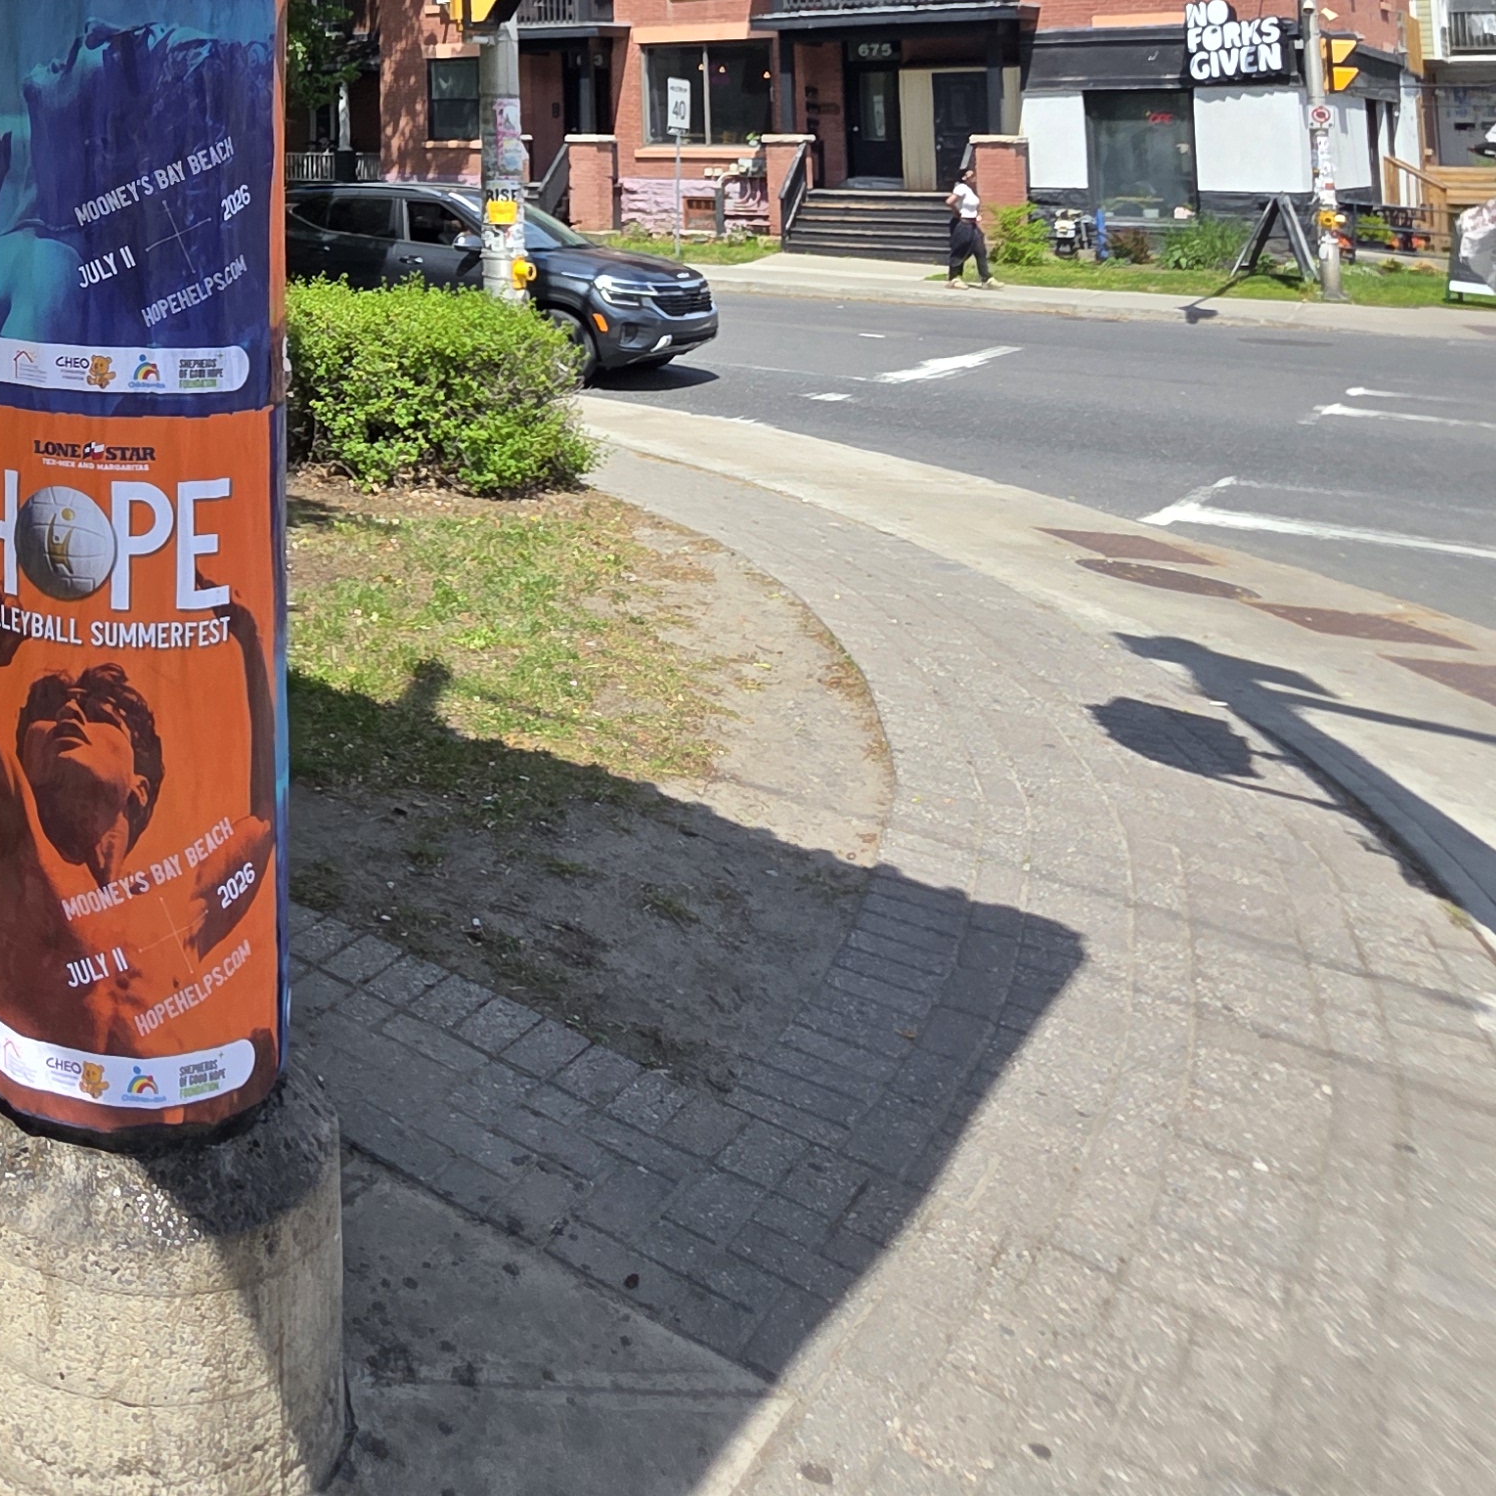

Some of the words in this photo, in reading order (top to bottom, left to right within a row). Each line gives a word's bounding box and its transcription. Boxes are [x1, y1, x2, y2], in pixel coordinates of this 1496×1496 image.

[1186, 0, 1229, 29] NO
[858, 43, 893, 57] 675
[1187, 16, 1281, 53] FORKS
[1190, 42, 1283, 80] GIVEN
[672, 100, 686, 120] 40
[74, 176, 154, 227] MOONEY'S
[154, 160, 186, 190] BAY
[187, 136, 234, 176] BEACH
[220, 184, 251, 221] 2026
[78, 252, 118, 288] JULY
[141, 254, 247, 328] HOPEHELPS.COM
[55, 356, 90, 369] CHEO
[34, 440, 81, 458] LONE
[105, 447, 156, 461] STAR
[77, 461, 95, 469] AND
[90, 616, 231, 648] SUMMERFEST
[61, 870, 150, 921] MOONEY'S
[150, 854, 183, 885] BAY
[184, 817, 235, 868] BEACH
[217, 862, 255, 909] 2026
[66, 952, 109, 988] JULY
[134, 938, 252, 1037] HOPEHELPS.COM
[46, 1057, 82, 1075] CHEO
